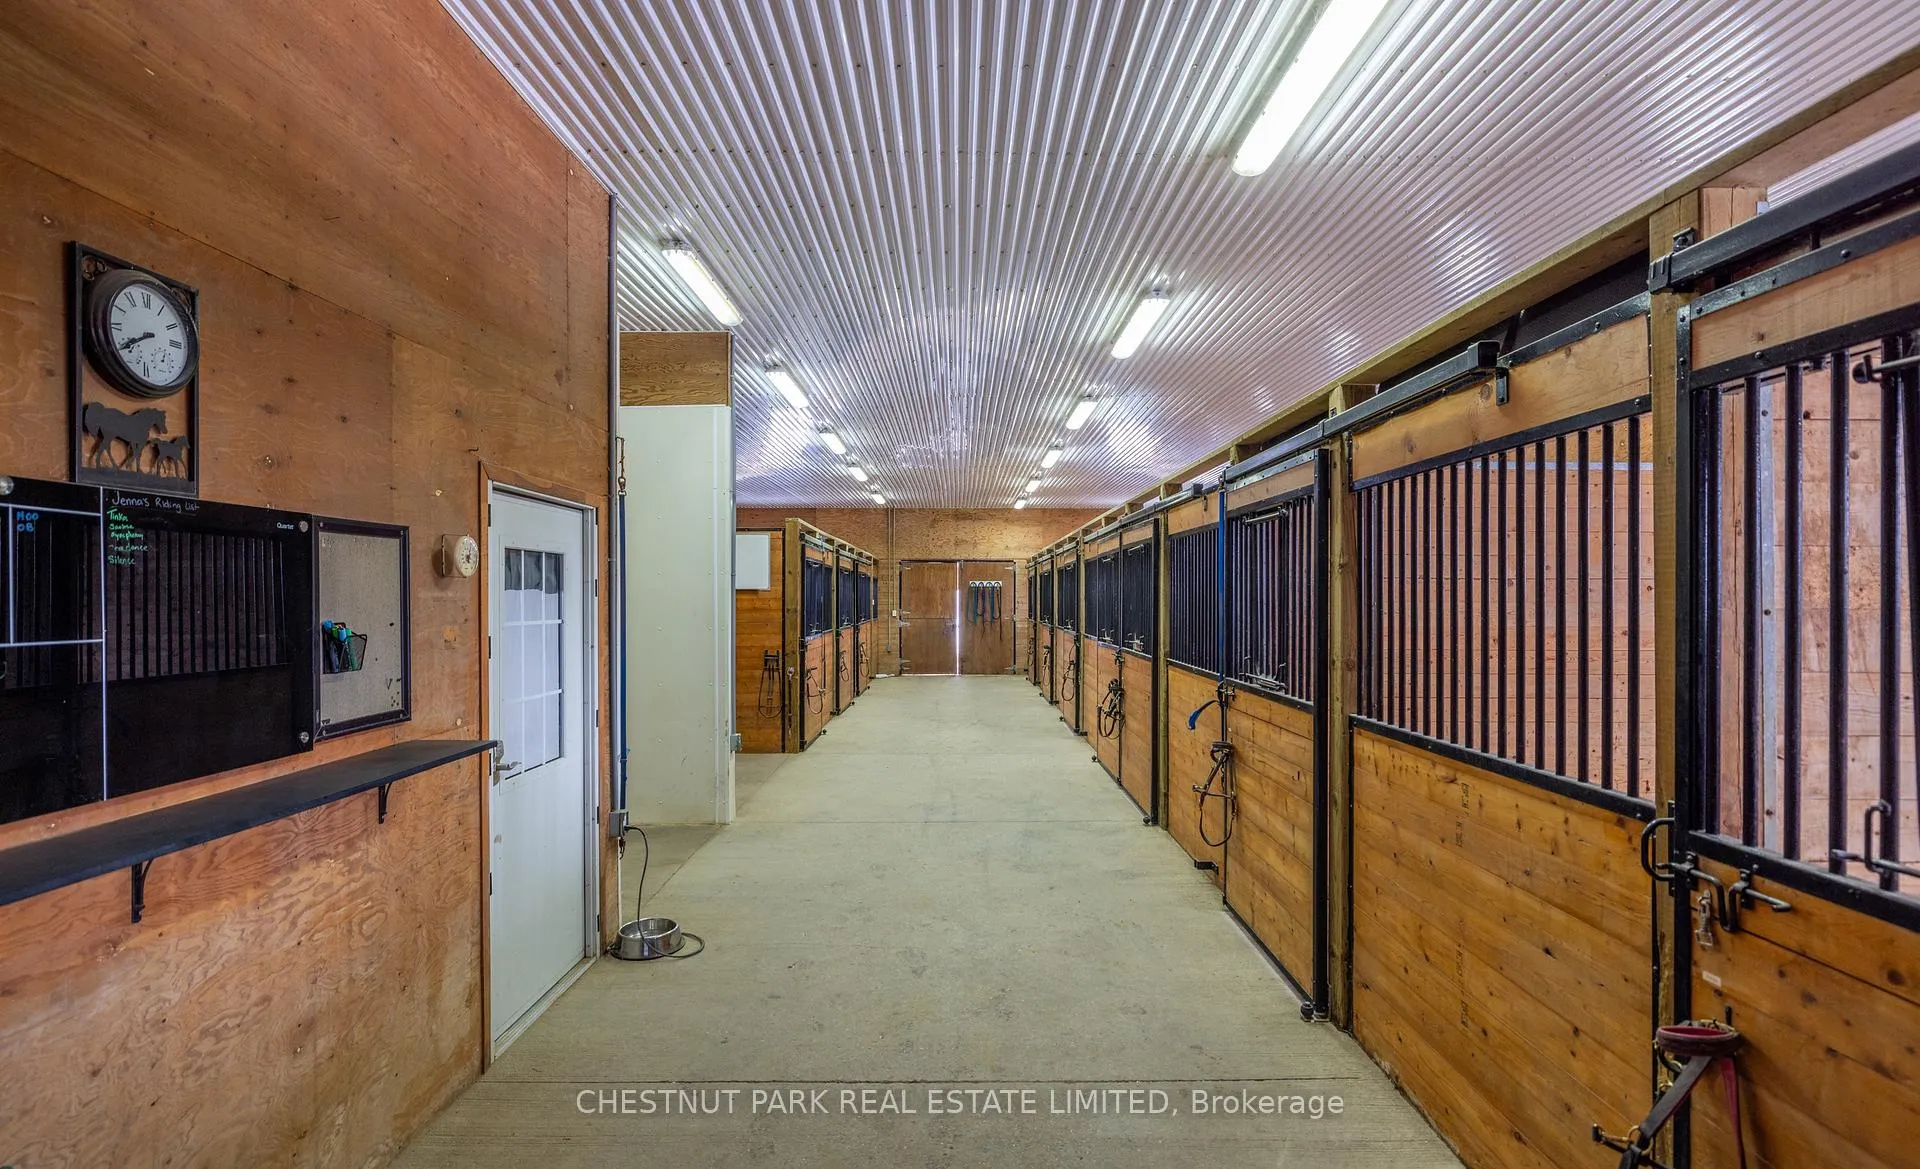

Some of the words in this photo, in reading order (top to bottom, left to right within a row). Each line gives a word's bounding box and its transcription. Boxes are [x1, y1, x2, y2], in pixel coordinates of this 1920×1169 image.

[112, 490, 150, 507] Jenna's
[155, 497, 182, 513] Riding
[185, 502, 200, 511] List
